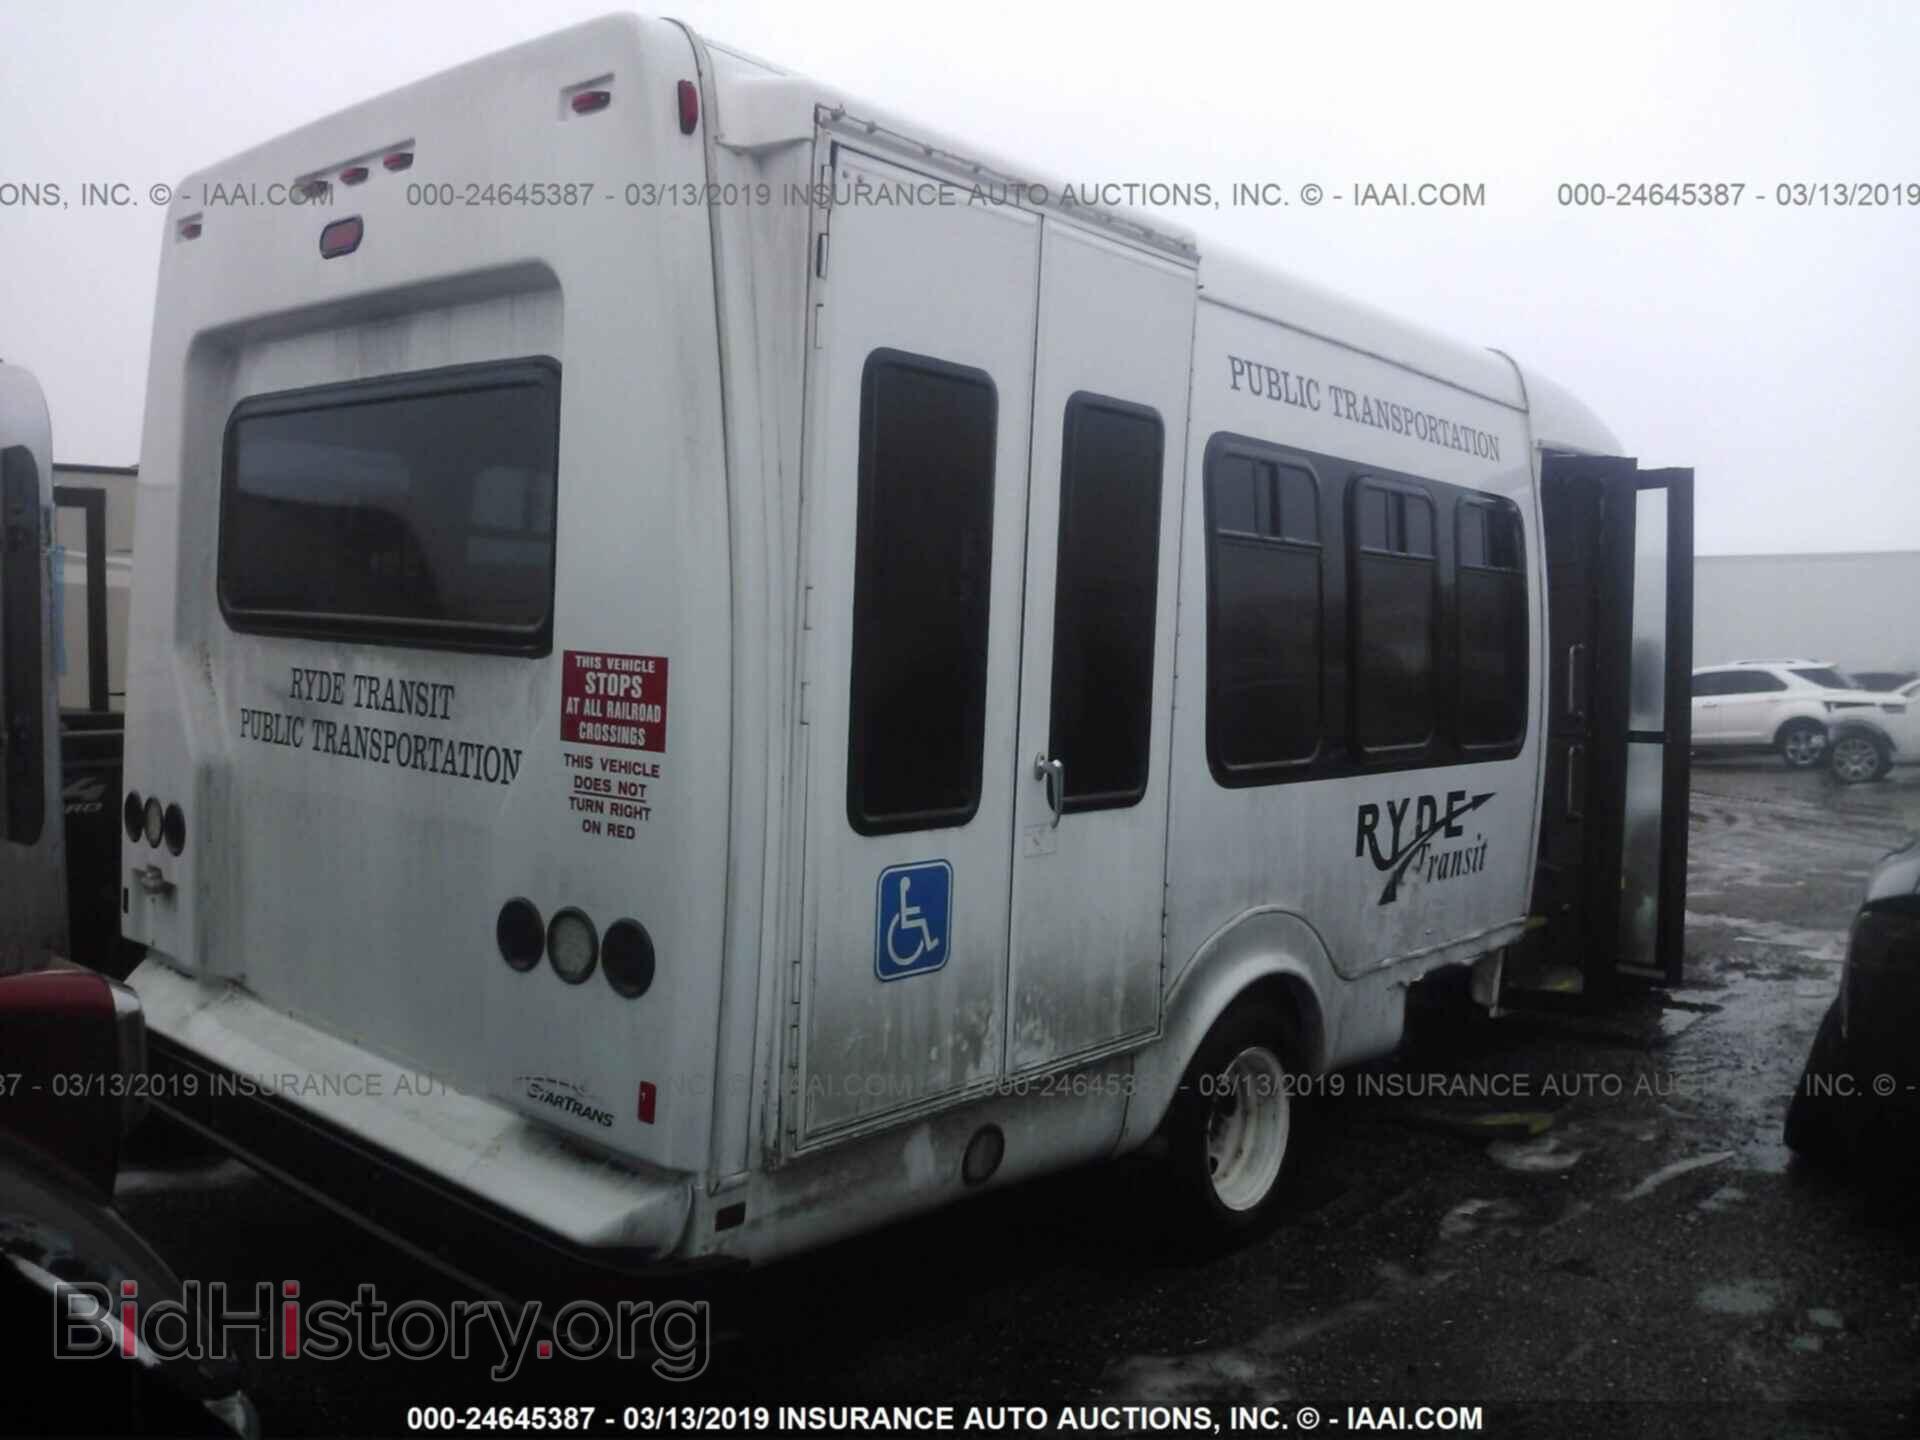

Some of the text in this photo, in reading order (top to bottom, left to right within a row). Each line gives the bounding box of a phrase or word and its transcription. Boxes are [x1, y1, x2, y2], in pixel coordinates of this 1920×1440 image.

[1227, 355, 1501, 462] PUBLIC TRANSPORTATION
[576, 655, 656, 674] THIS VEHICLE
[290, 667, 455, 720] RYDE TRANSIT
[585, 671, 642, 699] STOPS
[566, 697, 661, 724] AT ALL RAILROAD
[240, 708, 522, 785] PUBLIC TRANSPORTATION
[579, 721, 646, 747] CROSSINGS
[564, 753, 661, 779] THIS VEHICLE
[574, 775, 648, 798] DOES NOT
[569, 797, 652, 821] TURN RIGHT
[582, 819, 636, 841] ON RED
[1355, 790, 1467, 871] RYDE
[1413, 833, 1488, 884] Transit
